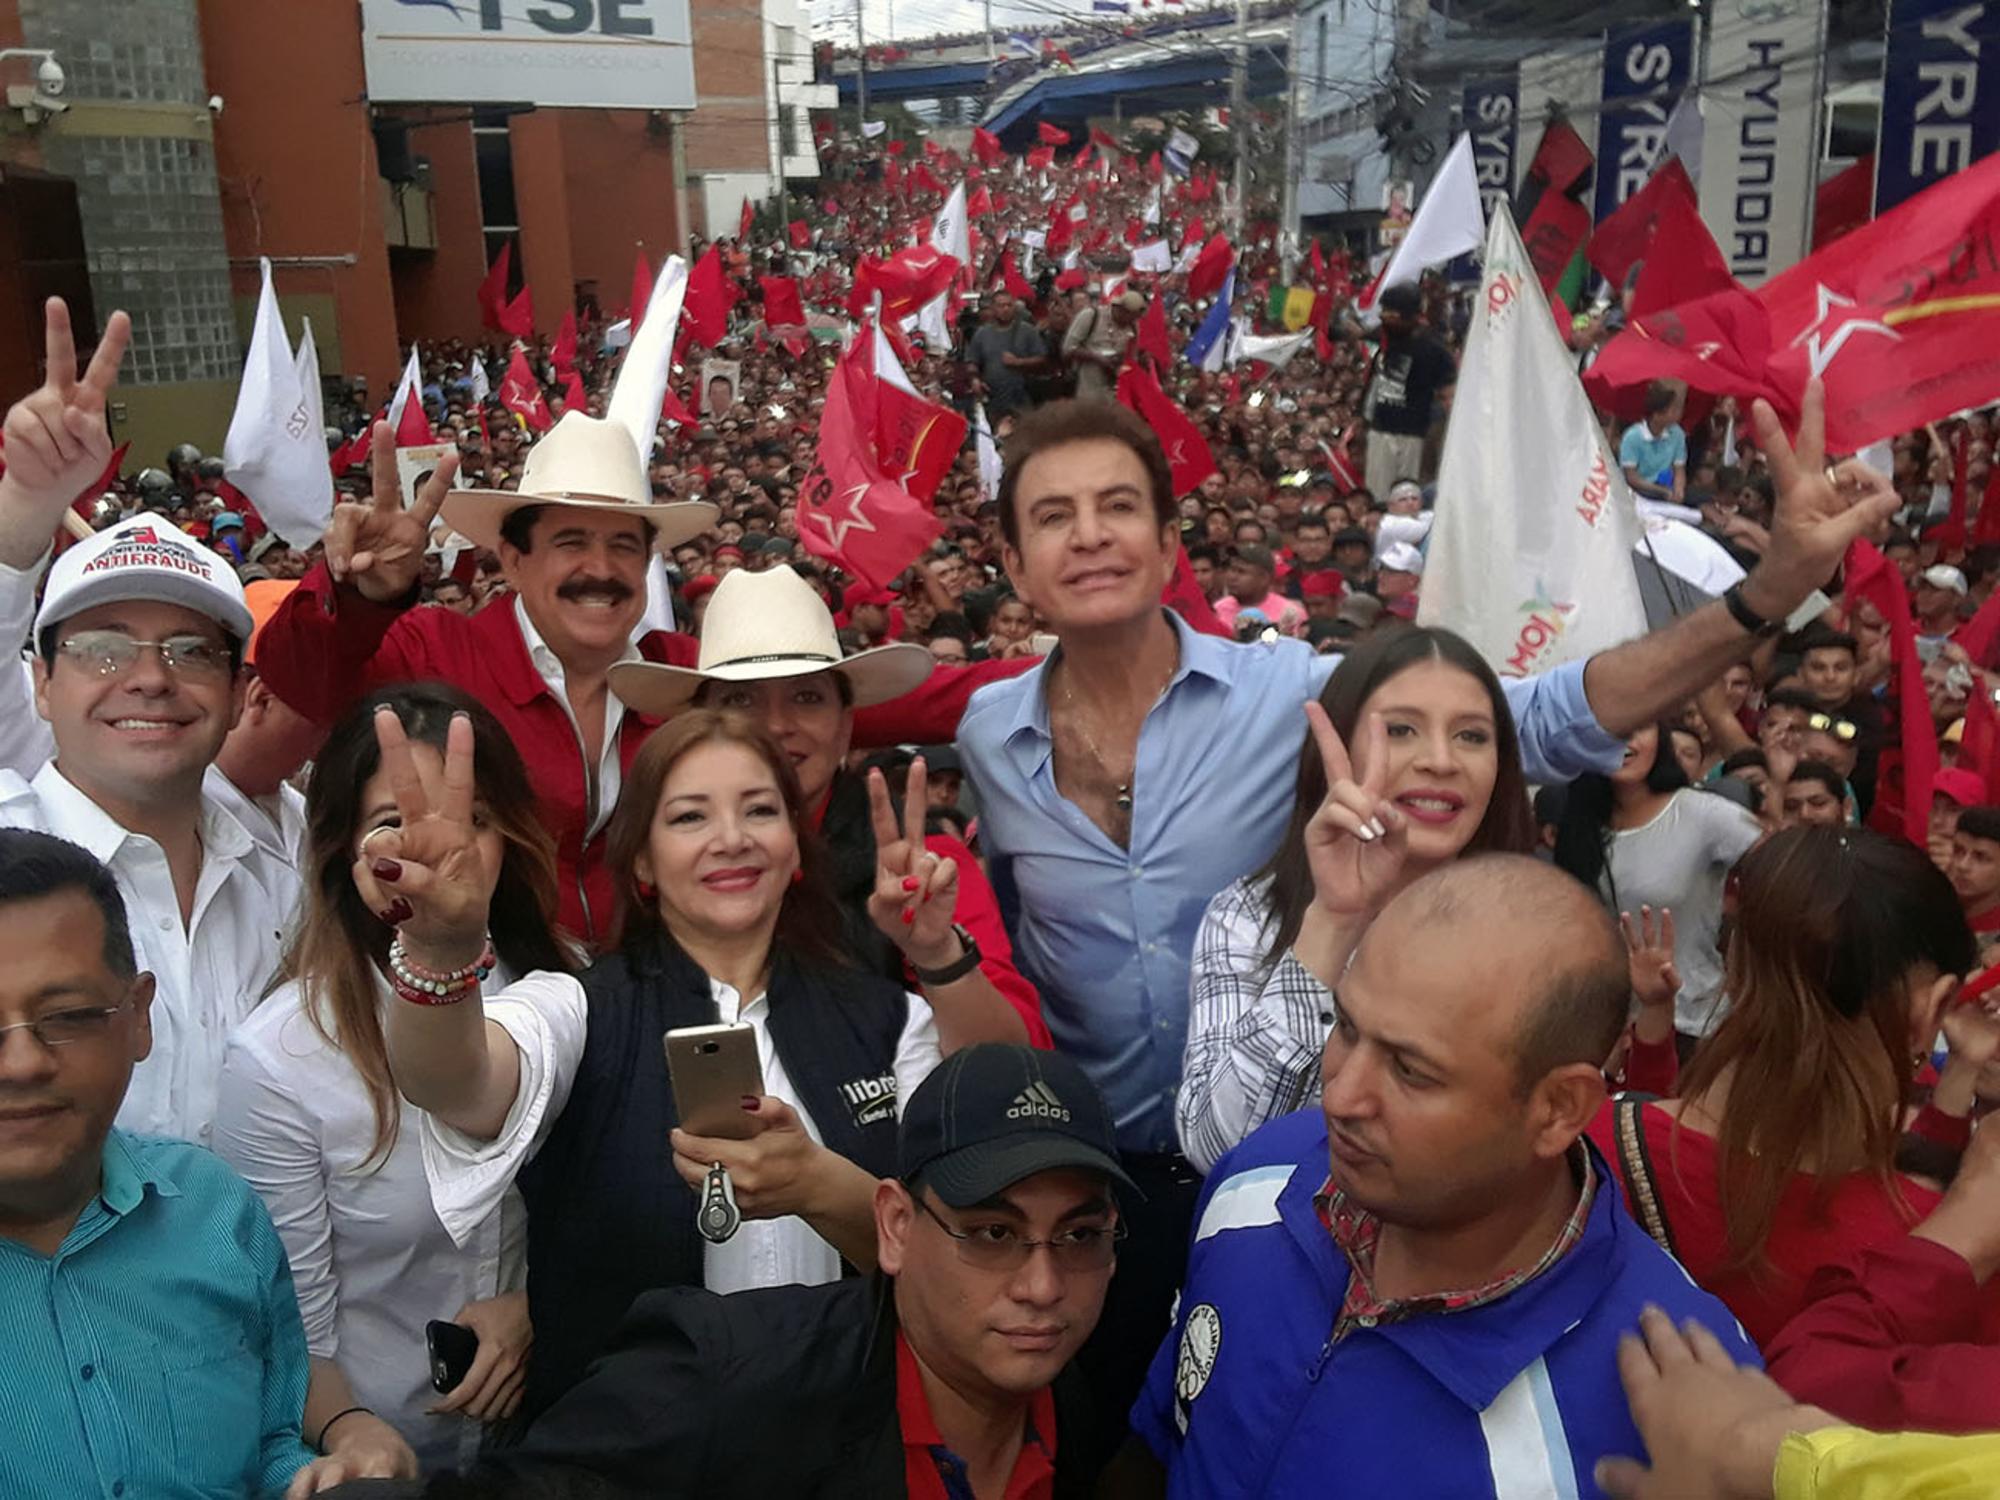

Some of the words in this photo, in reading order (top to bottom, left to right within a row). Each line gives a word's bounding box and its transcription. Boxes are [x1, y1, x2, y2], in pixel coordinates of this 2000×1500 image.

[1732, 39, 1784, 276] HYUNDAI
[82, 552, 213, 581] ANTIFRAUDE
[843, 1075, 898, 1104] libre
[1006, 1101, 1071, 1122] adidas
